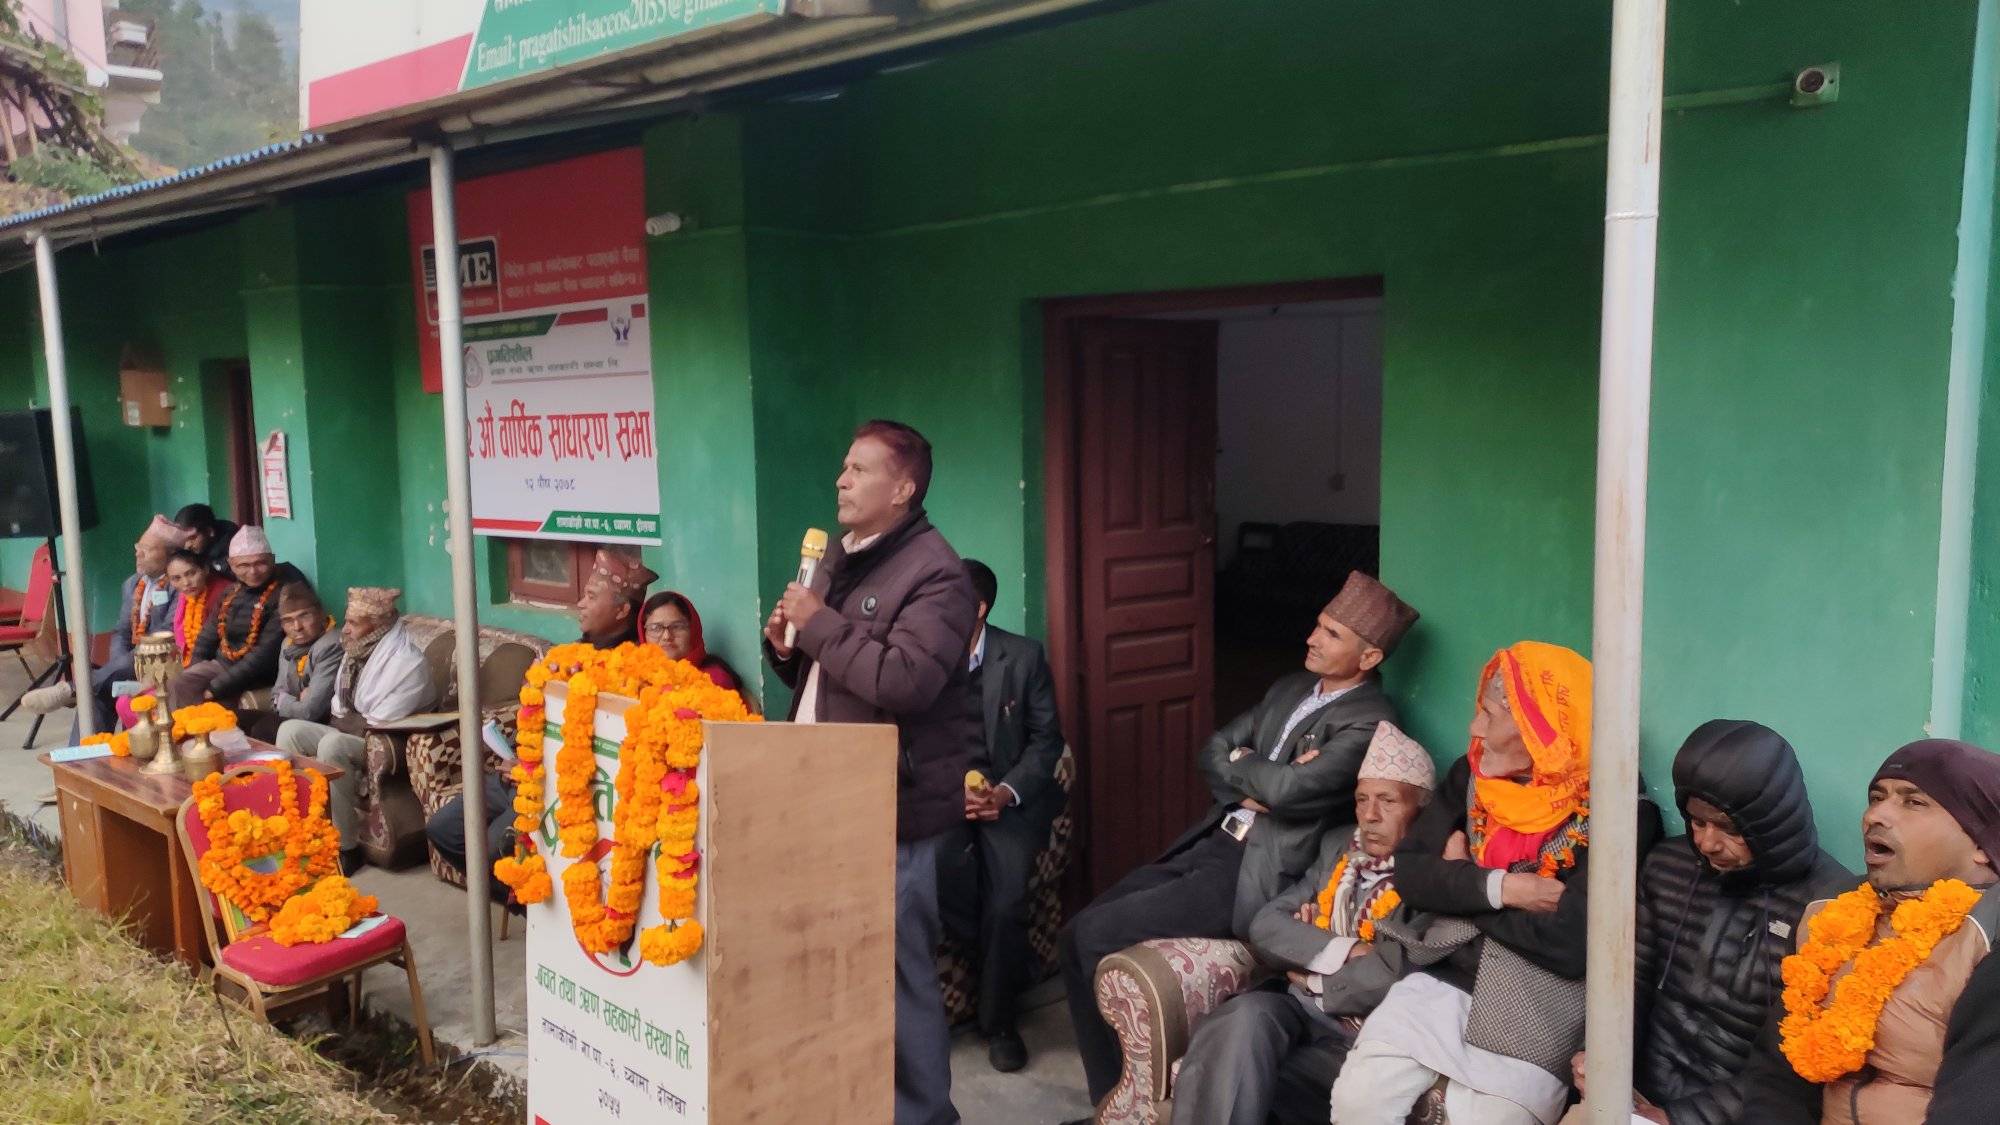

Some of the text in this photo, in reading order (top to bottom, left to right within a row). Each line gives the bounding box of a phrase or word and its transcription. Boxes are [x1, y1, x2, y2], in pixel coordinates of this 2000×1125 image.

[477, 34, 516, 72] Email:
[499, 399, 543, 458] वार्षिक
[547, 413, 610, 462] साधारण
[614, 411, 652, 463] सभा
[559, 975, 576, 1006] तथा
[579, 986, 600, 1019] ऋण
[603, 999, 641, 1042] सहकारी
[644, 1021, 672, 1060] संस्था
